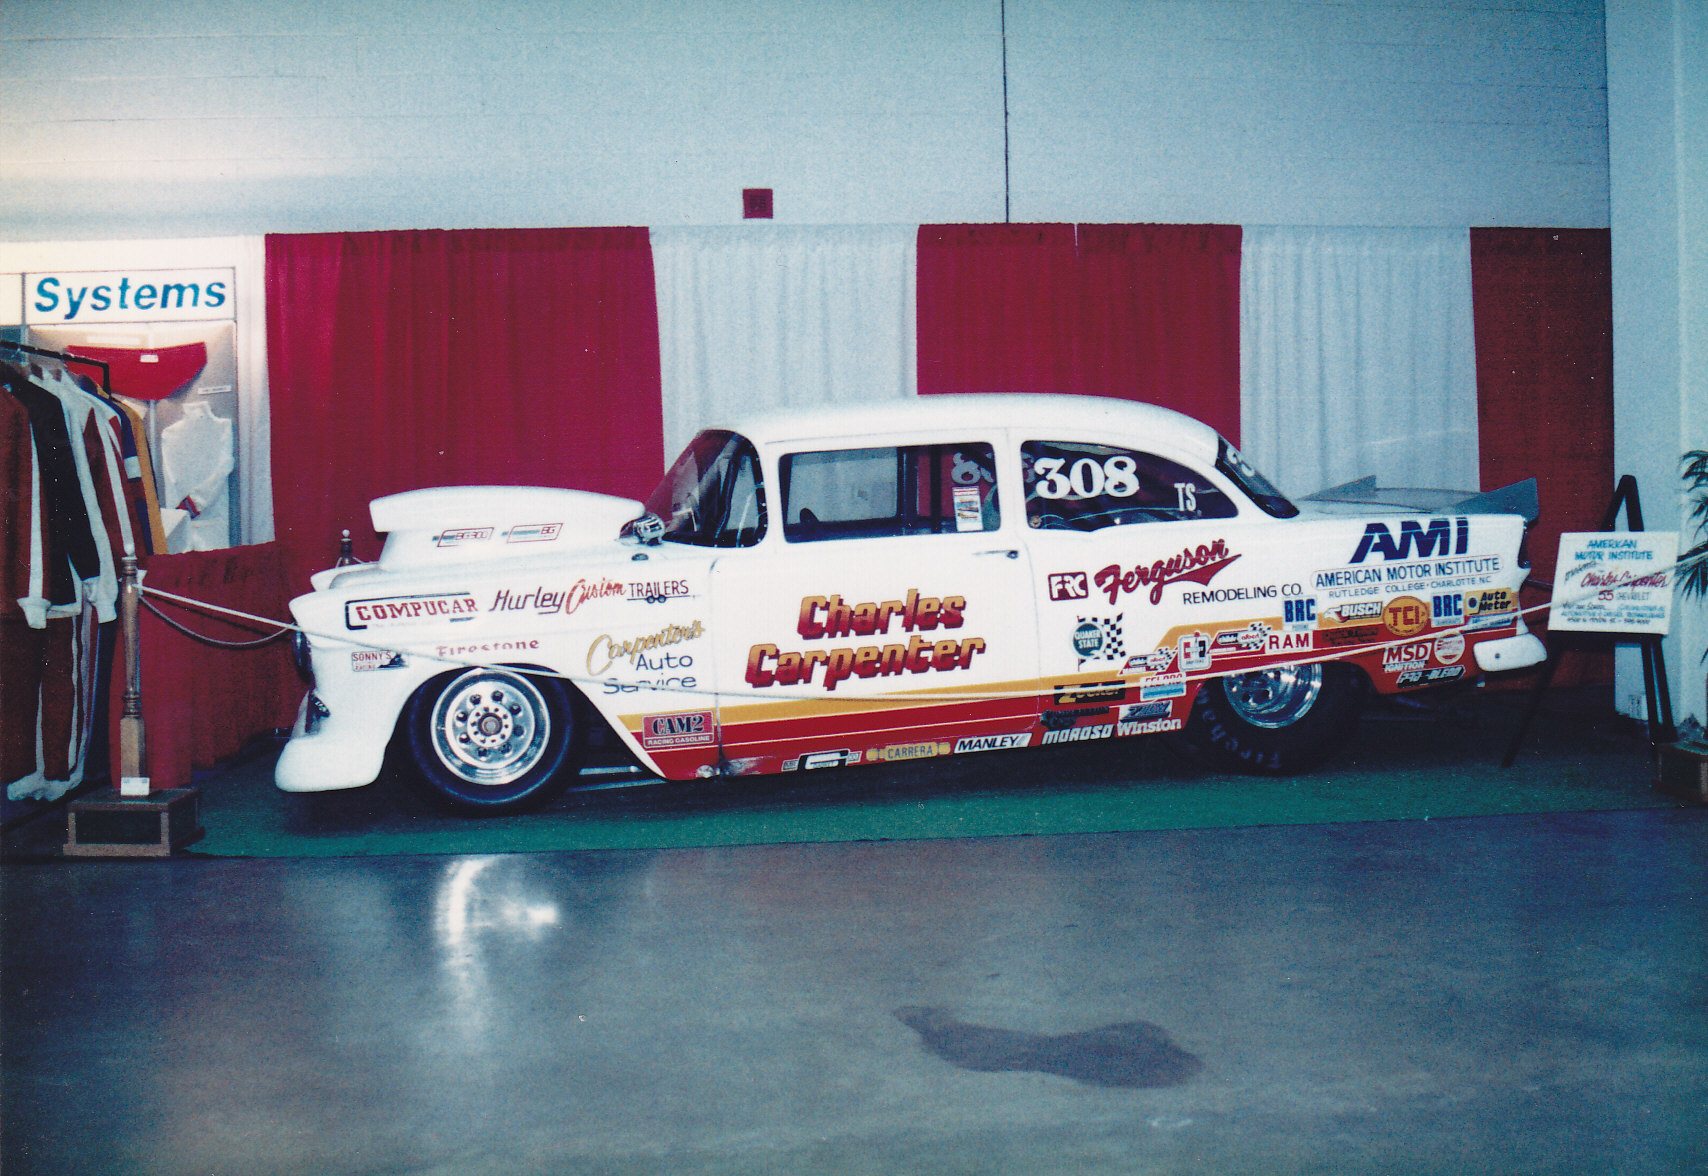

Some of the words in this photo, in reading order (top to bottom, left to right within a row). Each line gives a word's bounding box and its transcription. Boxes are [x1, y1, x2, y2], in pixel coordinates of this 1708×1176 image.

[34, 277, 226, 320] Systems
[1033, 456, 1140, 500] 308
[1174, 483, 1197, 512] TS
[1349, 517, 1469, 564] AMI
[1608, 550, 1654, 560] INSTITUTE
[1094, 538, 1229, 606] Ferguson
[1316, 568, 1382, 588] AMERICAN
[1387, 563, 1432, 581] MOTOR
[1435, 557, 1500, 576] INSTITUTE
[488, 586, 565, 615] Hurley
[628, 579, 690, 598] TRAILERS
[1183, 585, 1277, 605] REMODELING
[1281, 583, 1303, 597] CO.
[1328, 586, 1380, 599] RUTLEDGE
[1385, 582, 1425, 594] COLLEGE
[1431, 577, 1476, 589] CHARLOTTE
[1482, 591, 1507, 602] Auto
[355, 598, 479, 621] COMPUCAR
[797, 588, 966, 640] Charles
[1341, 602, 1382, 617] BUSCH
[1388, 605, 1420, 627] TCI
[1480, 600, 1512, 611] Meter
[435, 639, 541, 658] Firestone
[1269, 633, 1309, 650] RAM
[635, 652, 694, 671] Auto
[745, 635, 986, 691] Carpenter
[1386, 643, 1428, 663] MSD
[652, 714, 705, 736] CAM2
[1117, 718, 1182, 737] Winston
[675, 735, 710, 744] GASOLINE
[958, 735, 1019, 752] MANLEY
[887, 745, 934, 760] CARRERA
